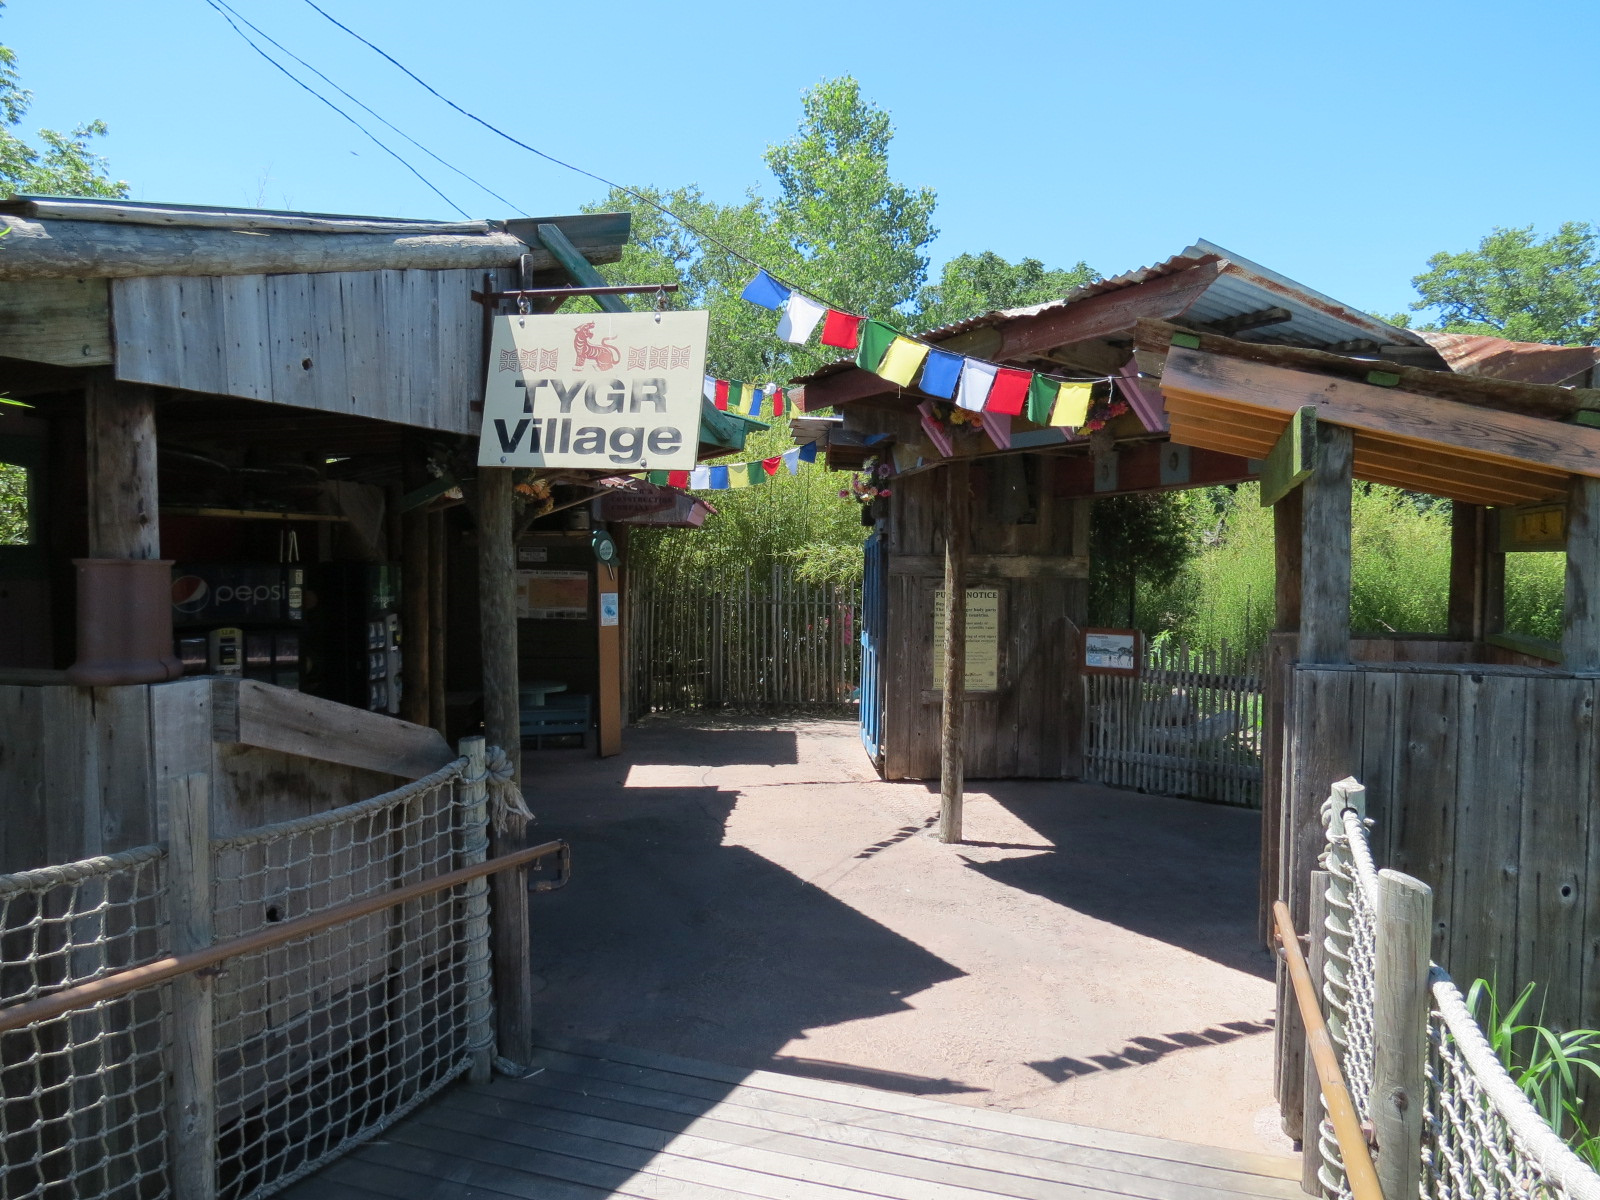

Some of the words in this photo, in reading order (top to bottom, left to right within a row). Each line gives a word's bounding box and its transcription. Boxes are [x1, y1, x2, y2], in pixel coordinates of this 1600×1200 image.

[514, 378, 668, 414] TYGR
[493, 418, 682, 464] Village
[215, 580, 287, 606] pepsi
[966, 591, 998, 599] NOTICE
